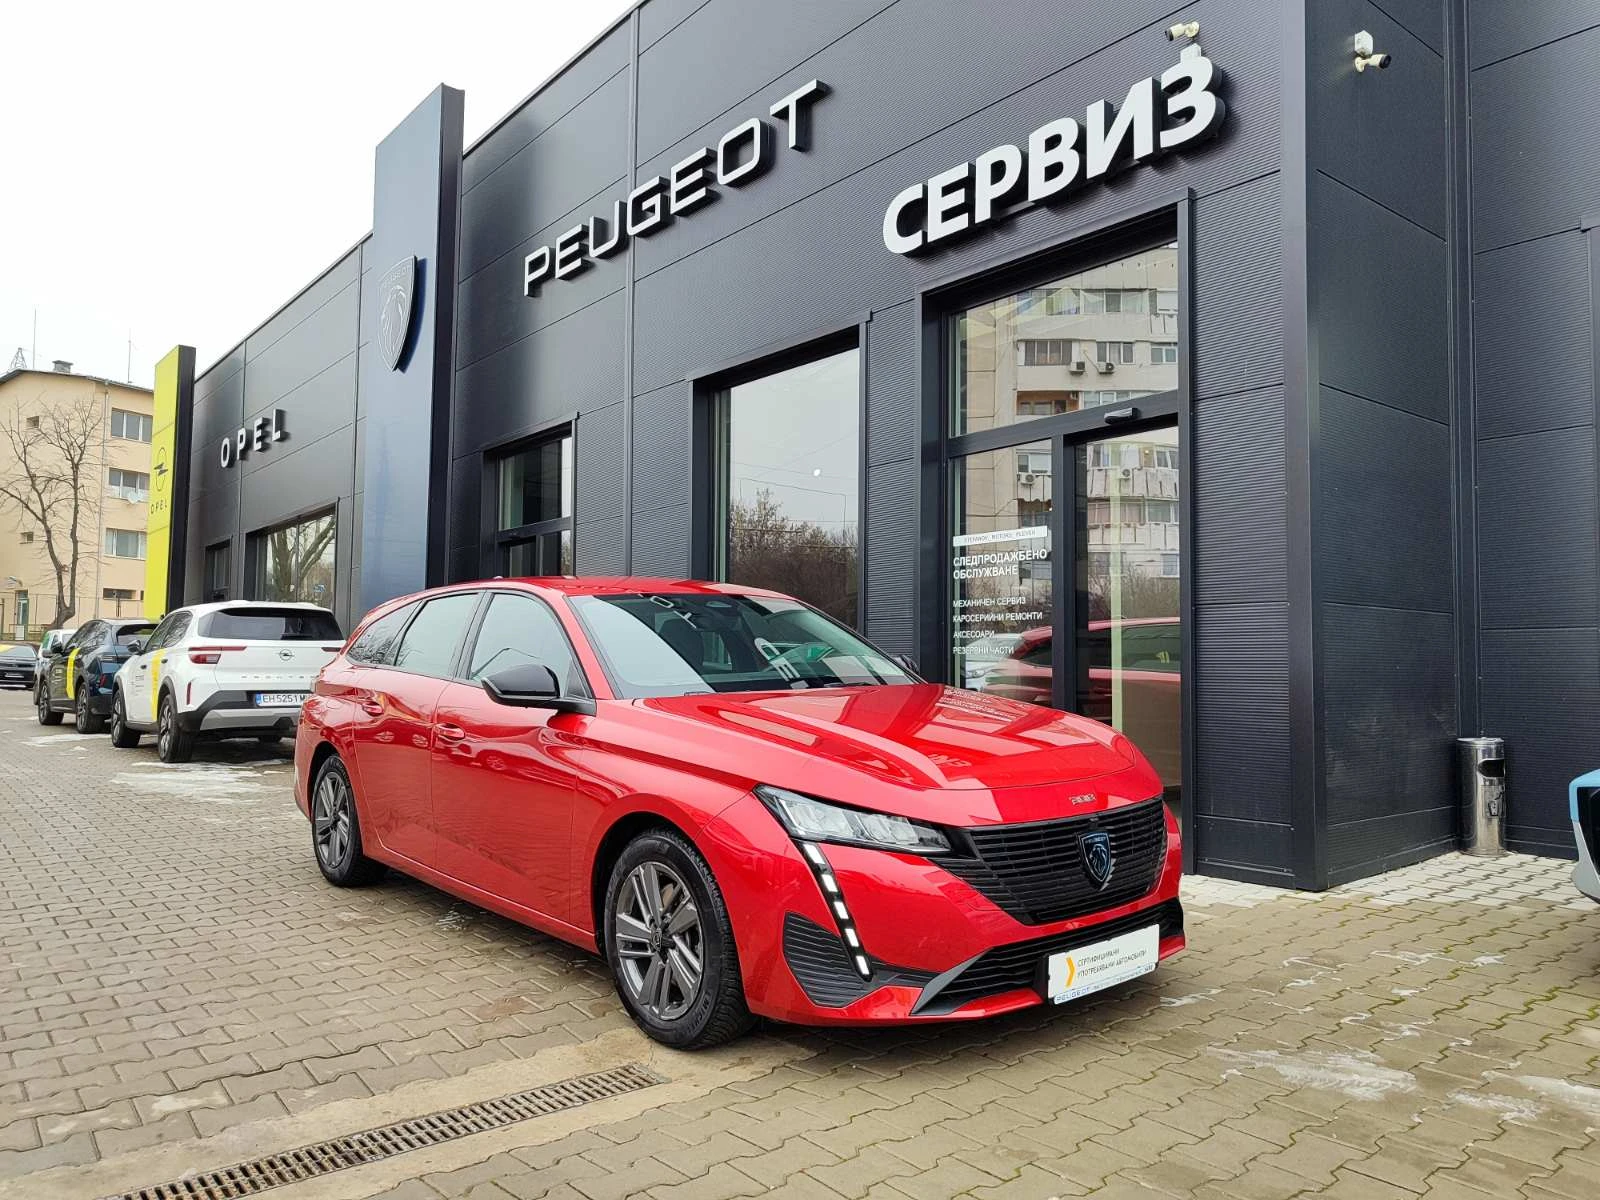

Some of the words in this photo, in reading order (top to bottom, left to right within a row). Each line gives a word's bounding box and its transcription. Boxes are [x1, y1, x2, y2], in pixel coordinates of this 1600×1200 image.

[882, 57, 1217, 254] СЕРВИЗ
[524, 79, 828, 296] PEUGEOT
[220, 408, 283, 468] OPEL
[150, 499, 168, 514] OPEL
[953, 549, 1048, 568] СЛЕДПРОДАЖБЕНО
[953, 565, 1018, 579] ОБСЛУЖВАНЕ
[953, 598, 996, 608] МЕХАНИЧЕН
[996, 597, 1026, 606] СЕРВИЗ
[953, 612, 1004, 622] КАРОСЕРИЙНИ
[1005, 611, 1043, 621] РЕМОНТИ
[953, 630, 995, 639] АКСЕСОАРИ
[989, 646, 1015, 655] ЧАСТИ
